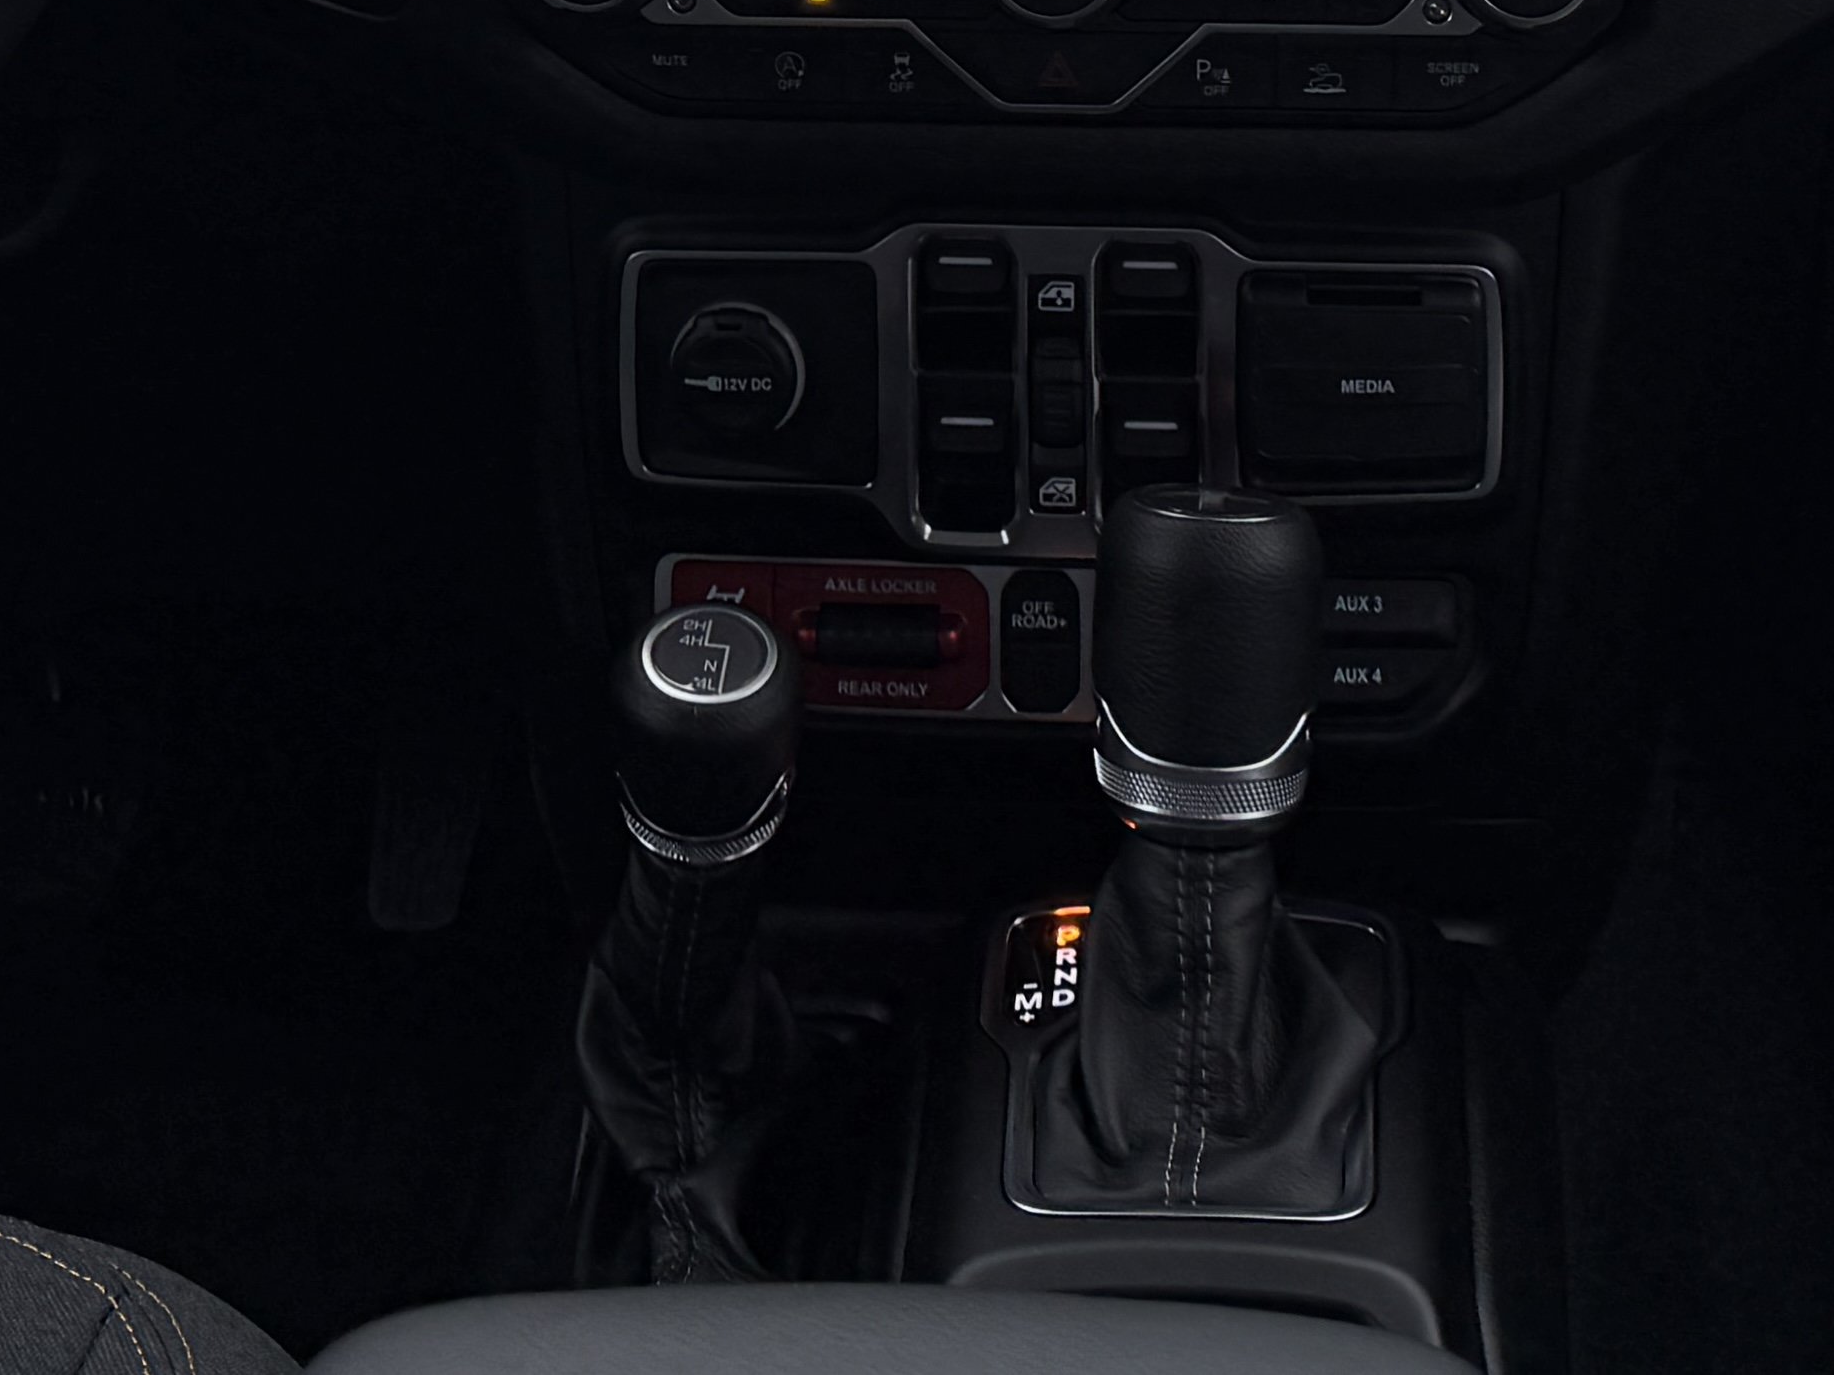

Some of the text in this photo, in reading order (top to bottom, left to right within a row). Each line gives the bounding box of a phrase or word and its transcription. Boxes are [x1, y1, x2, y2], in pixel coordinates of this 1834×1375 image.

[651, 53, 690, 68] MUTE
[1425, 62, 1481, 75] SCREEN
[776, 77, 803, 91] OFF
[1439, 75, 1466, 88] OFF
[722, 375, 773, 393] 12V DC
[1339, 377, 1396, 395] MEDIA
[823, 576, 938, 595] AXLE LOCKER
[1021, 599, 1055, 614] OFF
[1333, 594, 1383, 614] AUX 3
[682, 618, 707, 633] 2H
[678, 633, 704, 648] 4H
[703, 658, 719, 673] N
[1332, 666, 1383, 684] AUX 4
[837, 679, 929, 699] REAR ONLY
[1056, 925, 1082, 947] P
[1055, 947, 1078, 967] R
[1053, 967, 1079, 987] N
[1013, 991, 1044, 1013] M
[1050, 989, 1077, 1009] D
